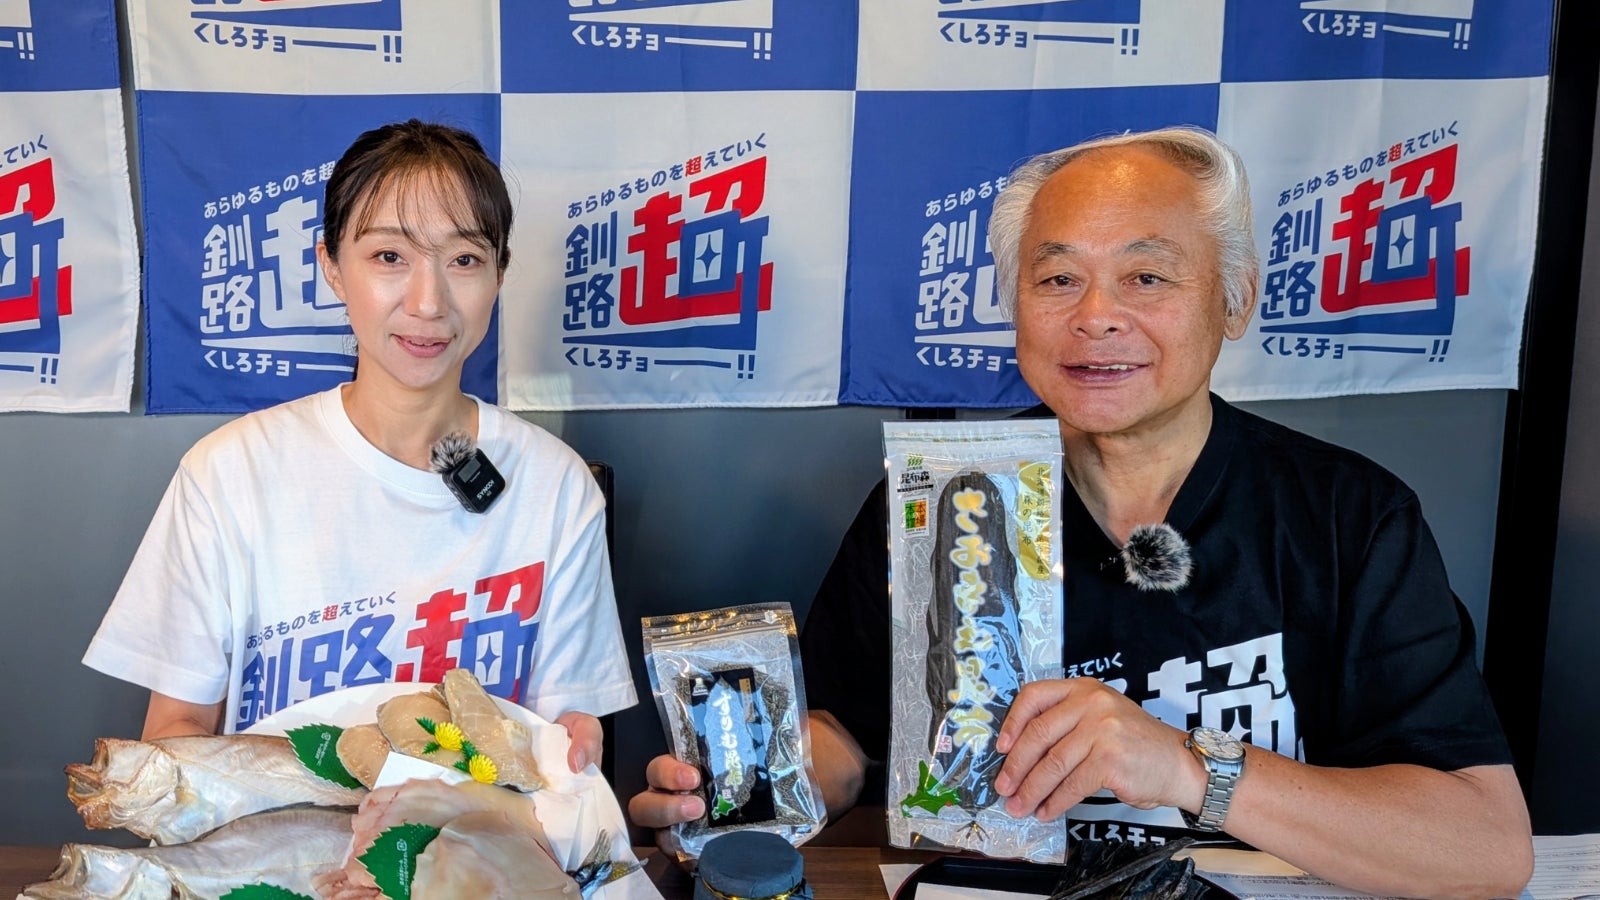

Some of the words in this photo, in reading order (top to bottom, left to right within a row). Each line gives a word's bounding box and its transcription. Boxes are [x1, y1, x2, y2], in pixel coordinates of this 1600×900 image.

[0, 134, 48, 168] ていく
[567, 132, 767, 219] あらゆるものを超えていく
[1277, 120, 1458, 208] あらゆるものを超えていく
[199, 214, 255, 334] 釧路
[562, 210, 618, 331] 釧路
[915, 209, 978, 330] 釧路
[1260, 197, 1323, 320] 釧路
[1063, 652, 1123, 679] えていく
